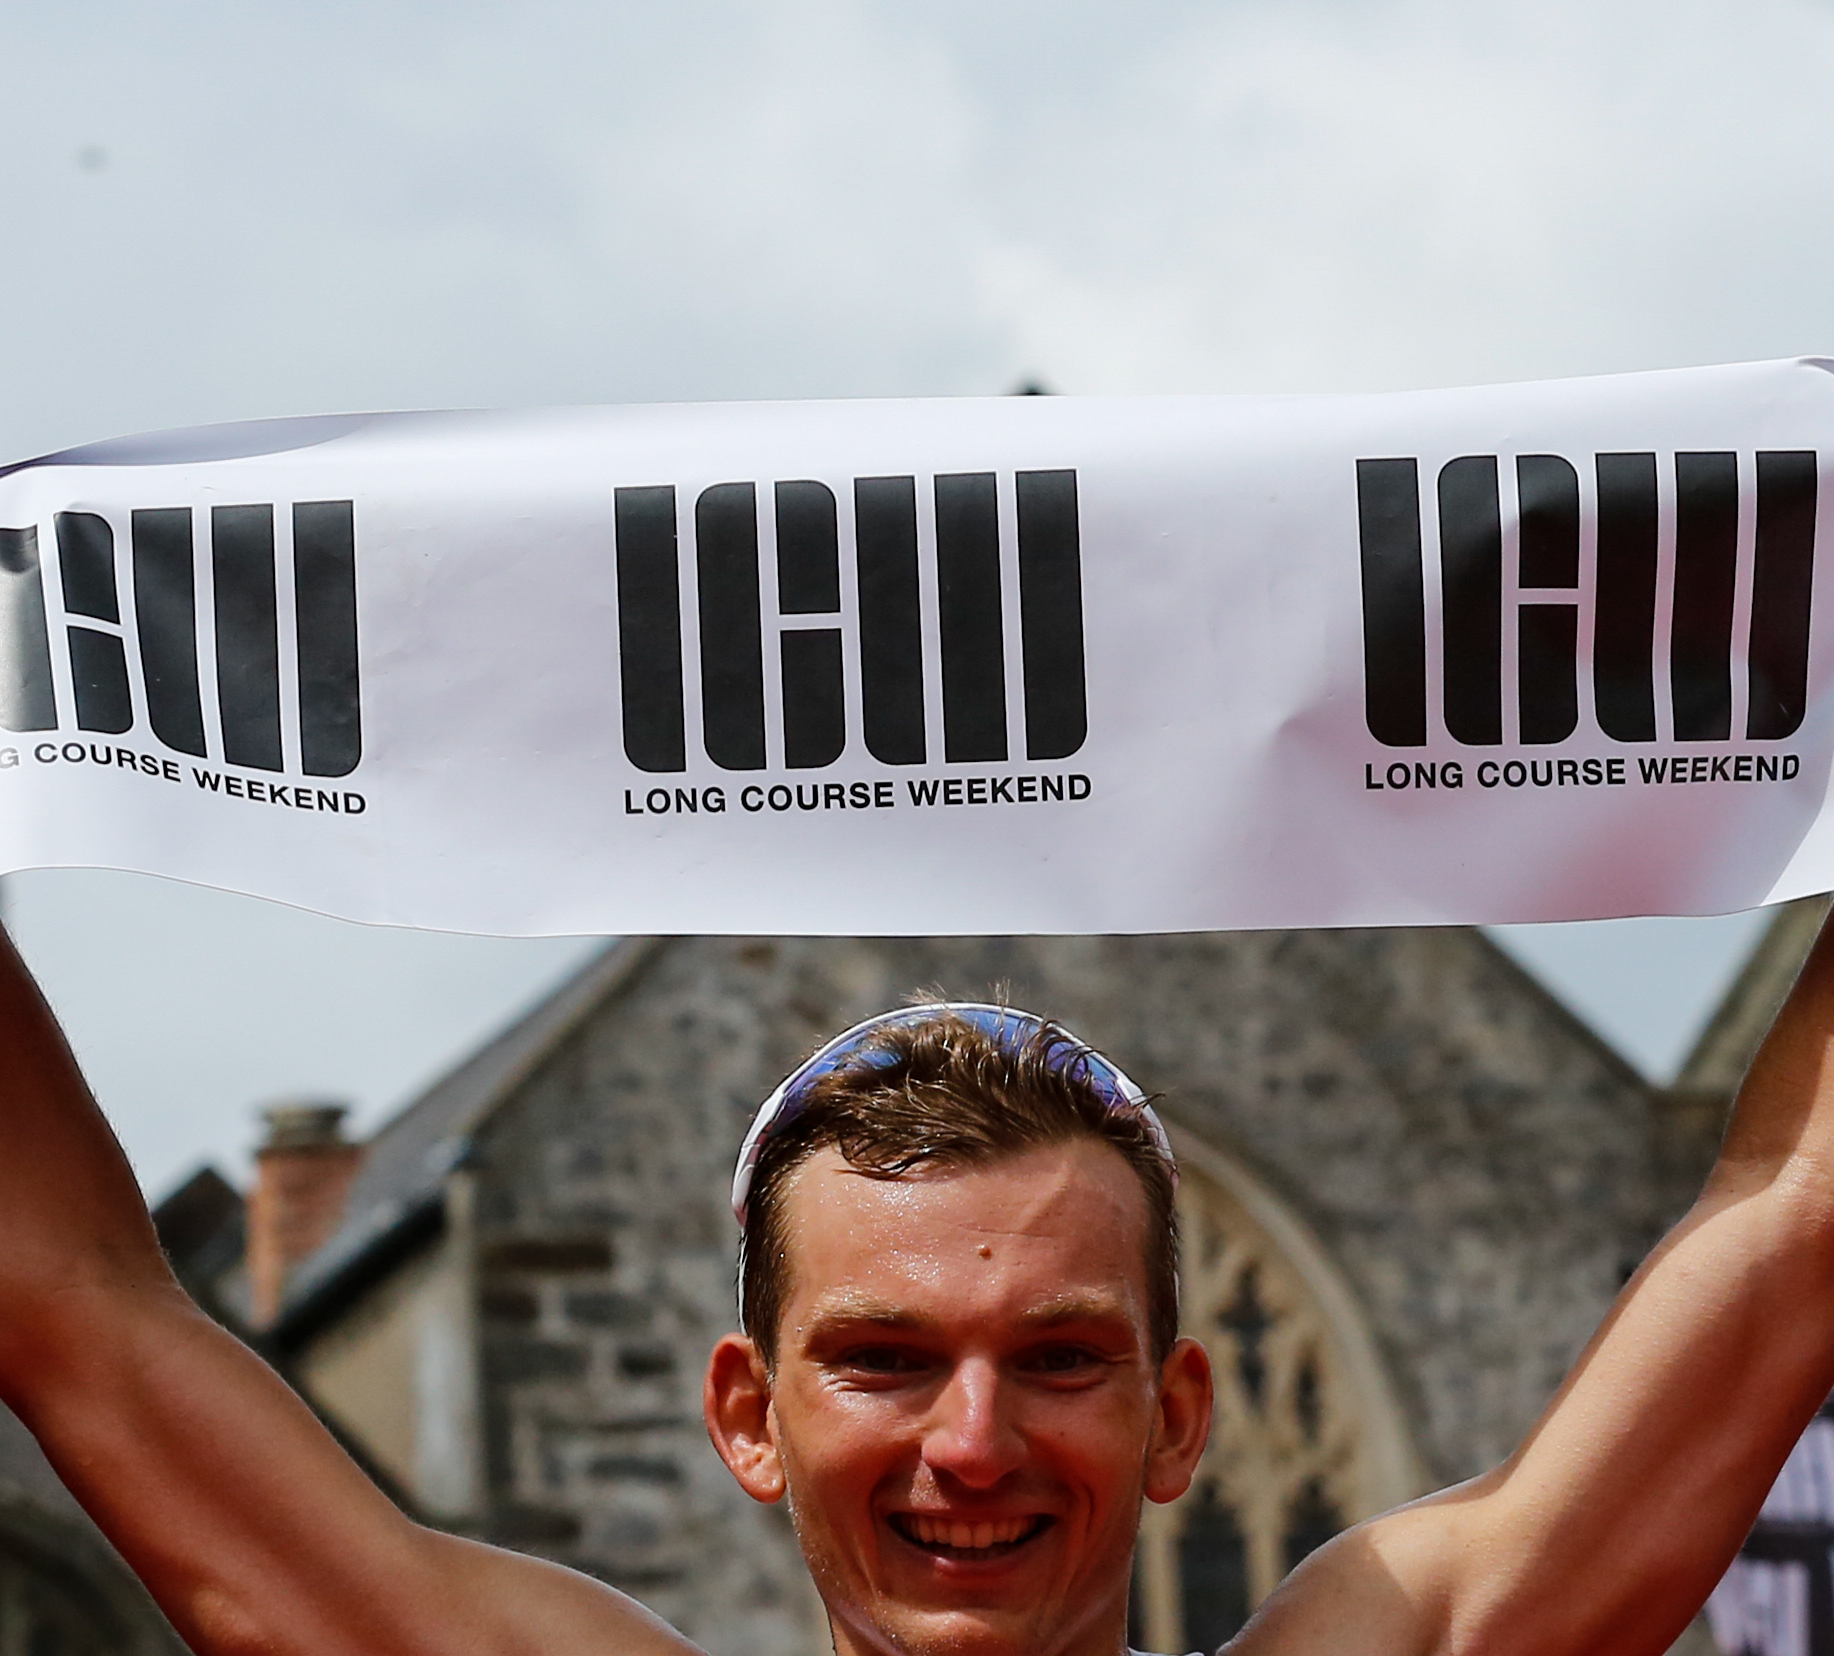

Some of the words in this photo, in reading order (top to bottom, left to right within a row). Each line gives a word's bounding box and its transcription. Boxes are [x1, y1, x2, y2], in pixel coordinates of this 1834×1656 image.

[34, 742, 182, 783] COURSE
[192, 767, 367, 816] WEEKEND
[1365, 761, 1464, 791] LONG
[1476, 757, 1627, 789] COURSE
[1637, 754, 1801, 785] WEEKEND
[624, 786, 727, 815] LONG
[739, 781, 895, 812] COURSE
[907, 774, 1092, 807] WEEKEND
